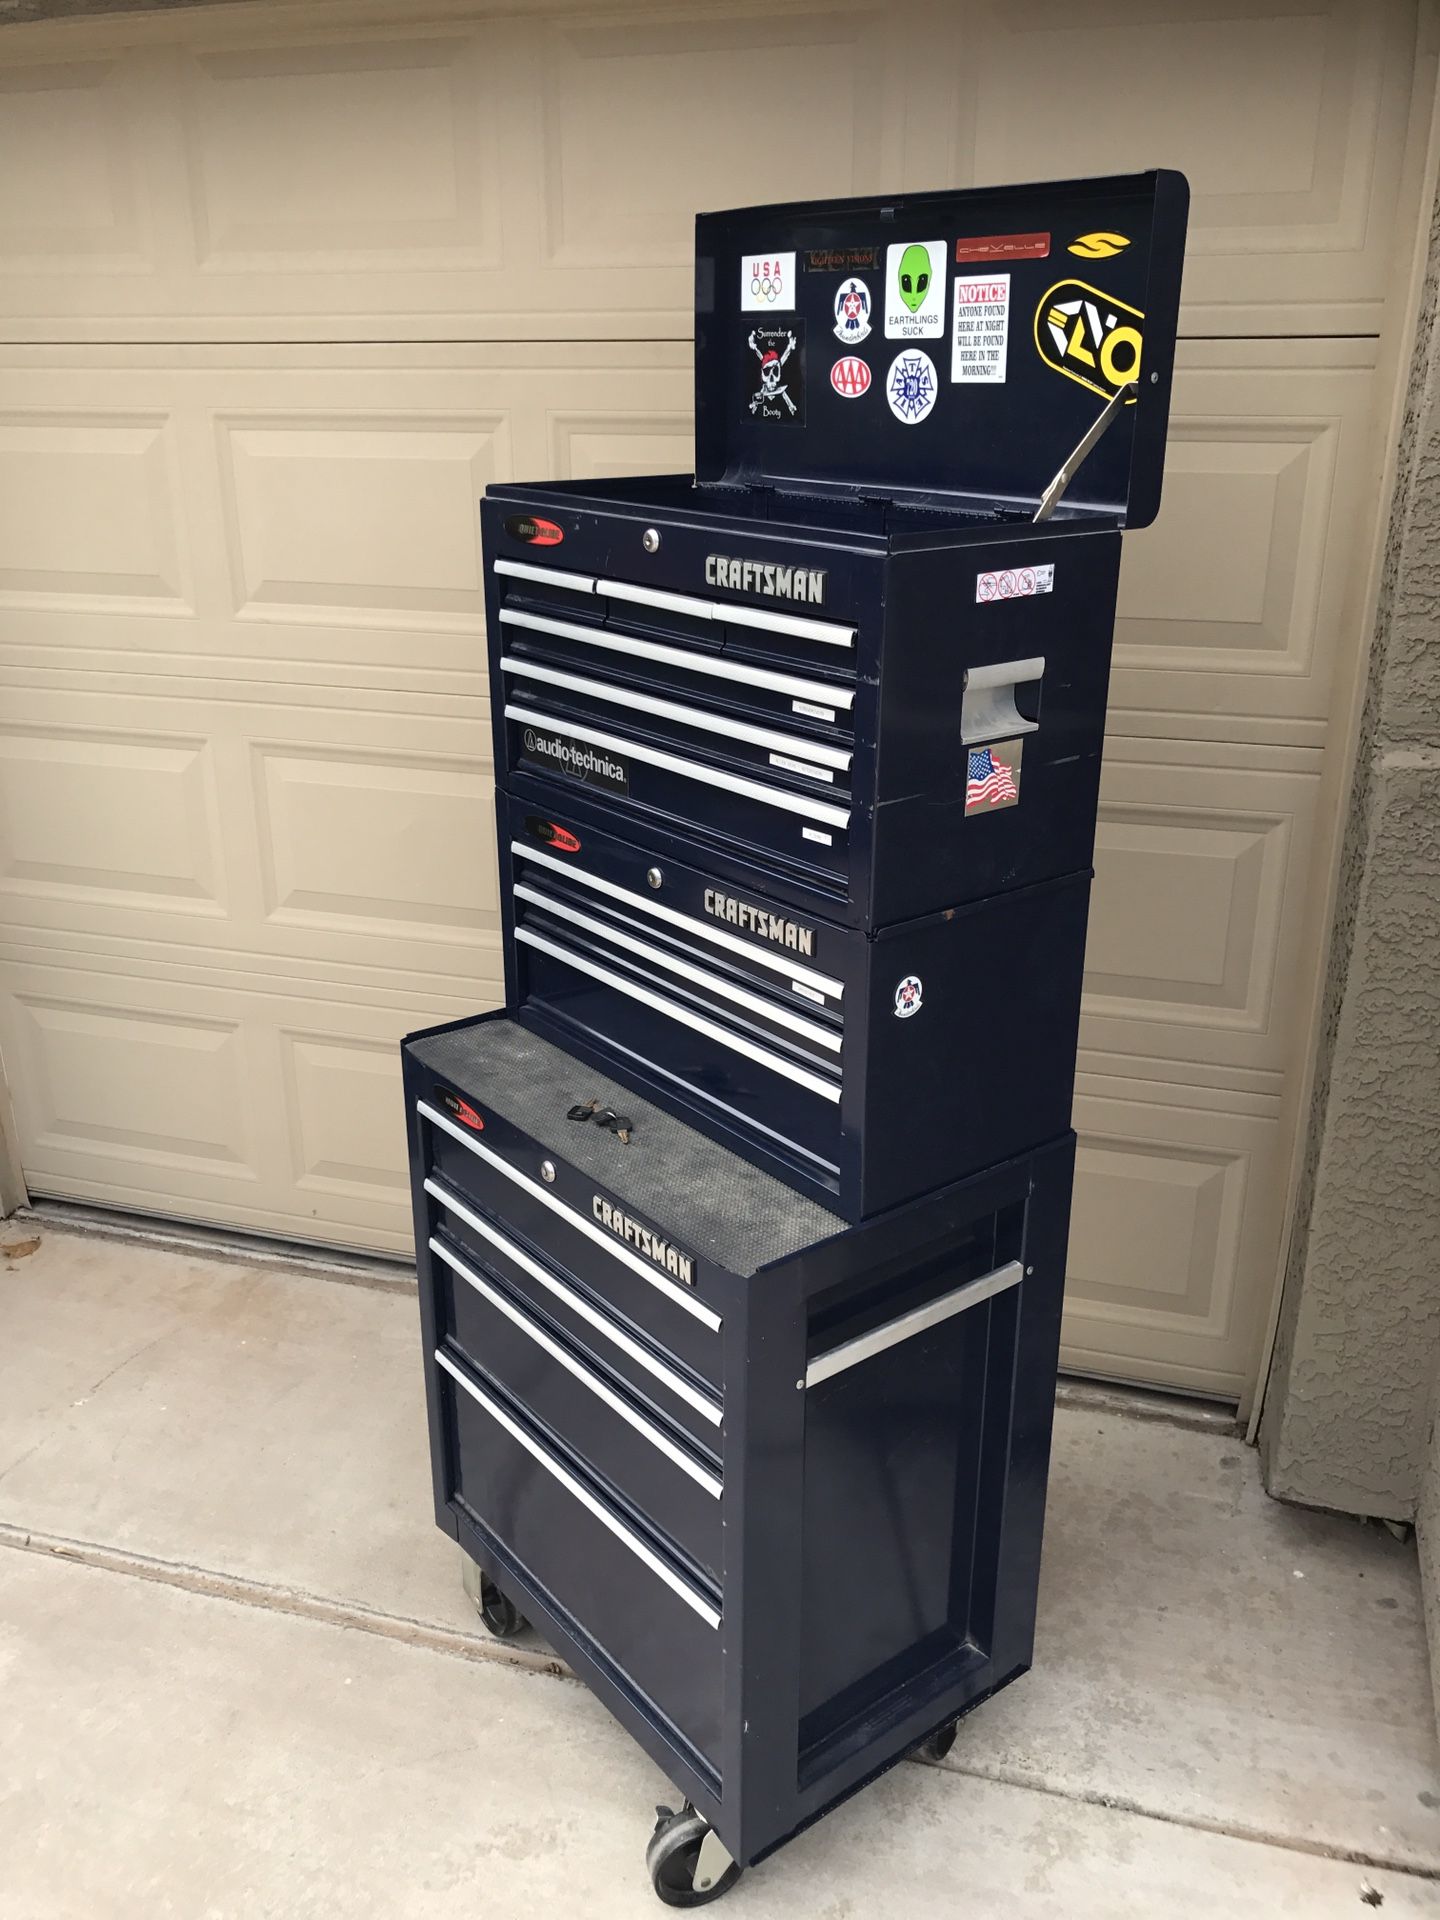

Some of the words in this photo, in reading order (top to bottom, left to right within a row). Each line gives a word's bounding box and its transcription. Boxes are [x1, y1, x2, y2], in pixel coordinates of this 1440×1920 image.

[752, 261, 782, 278] USA
[959, 284, 1006, 302] NOTICE
[958, 305, 982, 317] ANYONE
[984, 305, 1005, 316] FOUND
[889, 315, 938, 325] EARTHLINGS
[958, 321, 974, 332] HERE
[976, 320, 983, 332] AT
[985, 320, 1005, 331] NIGHT
[757, 327, 787, 340] Surrender
[902, 326, 923, 336] SUCK
[767, 339, 776, 347] the
[958, 336, 972, 347] WILL
[973, 336, 981, 347] BE
[983, 335, 1004, 346] FOUND
[960, 350, 977, 361] HERE
[979, 350, 985, 361] IN
[987, 350, 999, 361] THE
[834, 359, 869, 394] AAA
[763, 405, 781, 419] Booty
[705, 555, 825, 604] CRAFTSMAN
[704, 887, 814, 957] CRAFTSMAN
[592, 1194, 694, 1286] CRAFTSMAN
